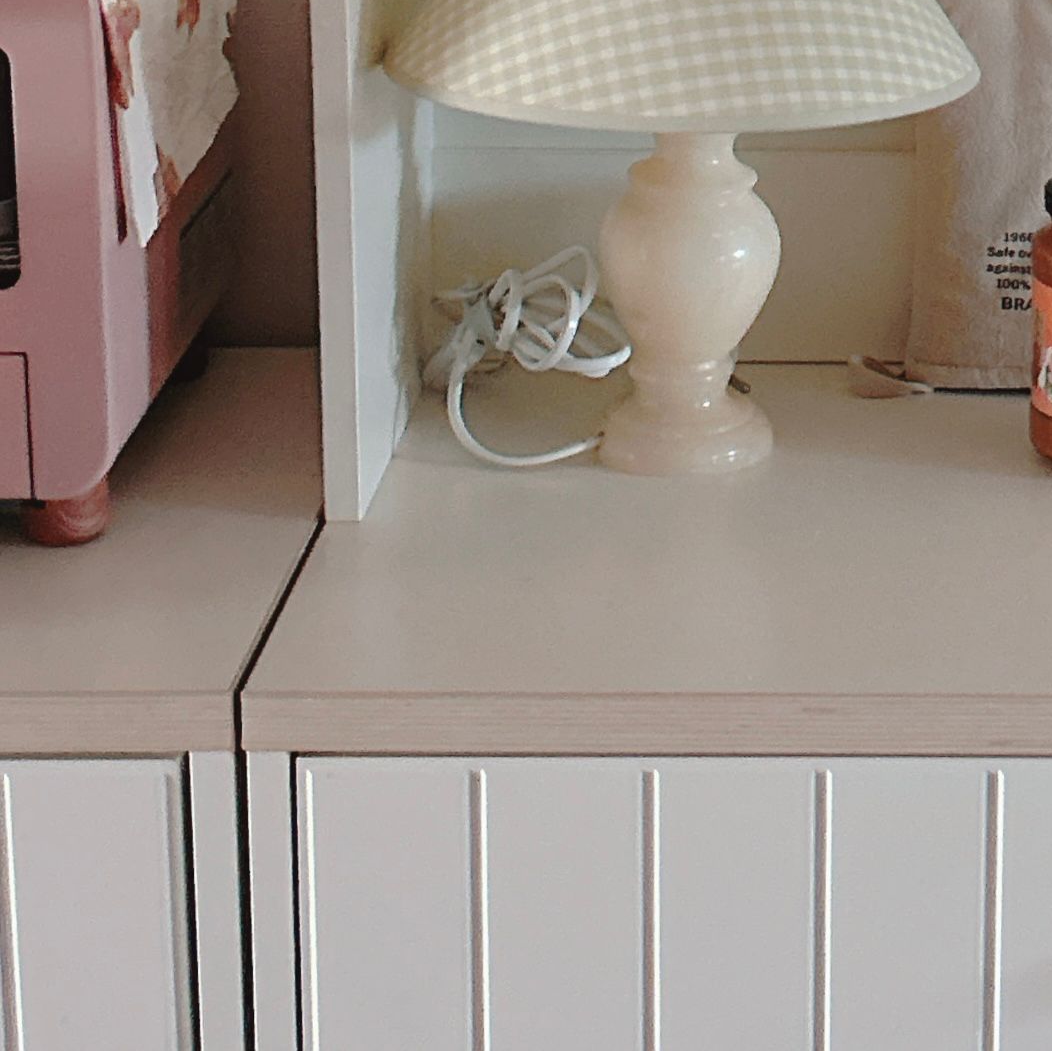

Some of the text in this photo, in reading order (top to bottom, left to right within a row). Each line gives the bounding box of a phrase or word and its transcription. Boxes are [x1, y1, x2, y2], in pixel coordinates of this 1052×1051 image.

[987, 247, 1015, 258] Safe
[986, 263, 1031, 275] against
[997, 278, 1031, 290] 100%
